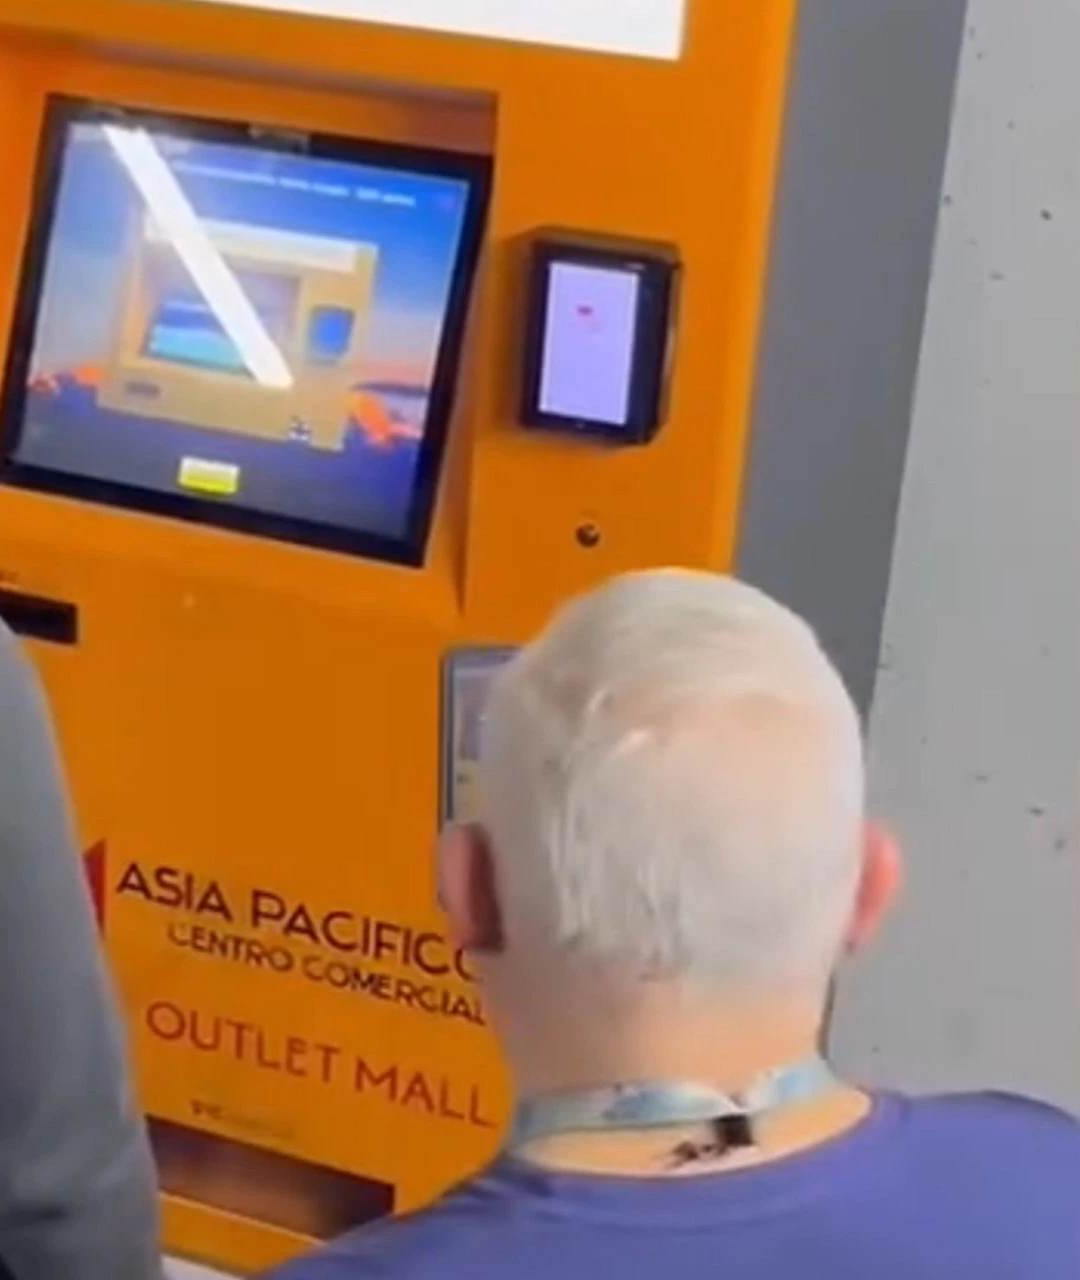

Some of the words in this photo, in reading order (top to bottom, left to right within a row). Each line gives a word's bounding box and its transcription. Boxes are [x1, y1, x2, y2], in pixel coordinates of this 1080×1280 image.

[115, 861, 234, 922] ASIA
[166, 922, 294, 973] CENTRO
[145, 1000, 341, 1083] OUTLET
[353, 1055, 499, 1129] MALL
